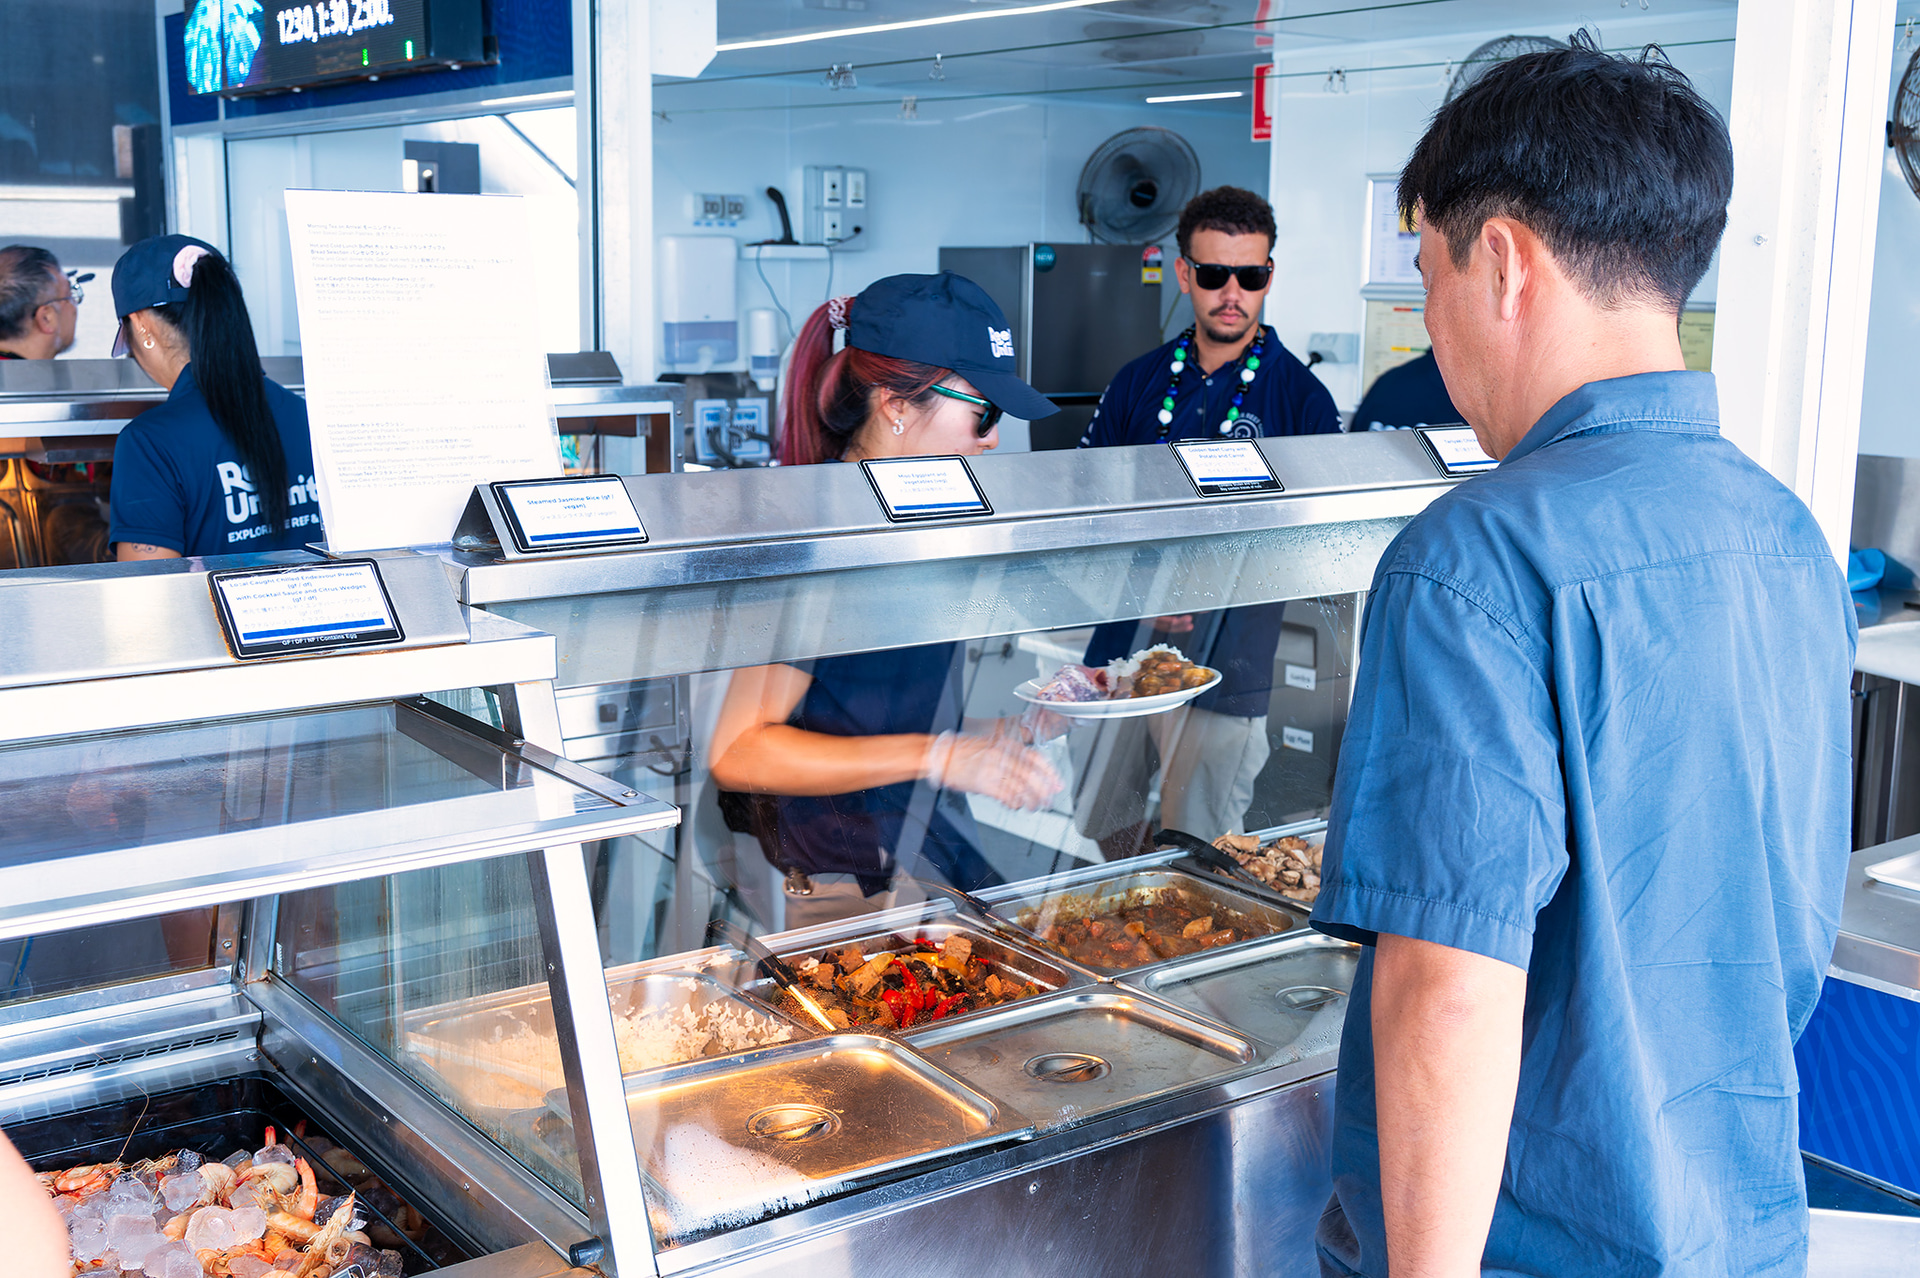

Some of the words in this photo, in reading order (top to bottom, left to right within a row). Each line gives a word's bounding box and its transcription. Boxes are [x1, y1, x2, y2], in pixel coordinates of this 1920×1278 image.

[526, 497, 557, 505] Steamed
[557, 496, 585, 504] Jasmine
[249, 578, 275, 587] Caught
[300, 573, 337, 581] Endeavour
[337, 570, 363, 578] Prawns
[287, 582, 297, 590] (gf
[235, 594, 252, 602] with
[252, 591, 282, 600] Cocktail
[282, 589, 303, 597] Sauce
[339, 583, 367, 592] Wedges
[292, 596, 303, 604] (gf
